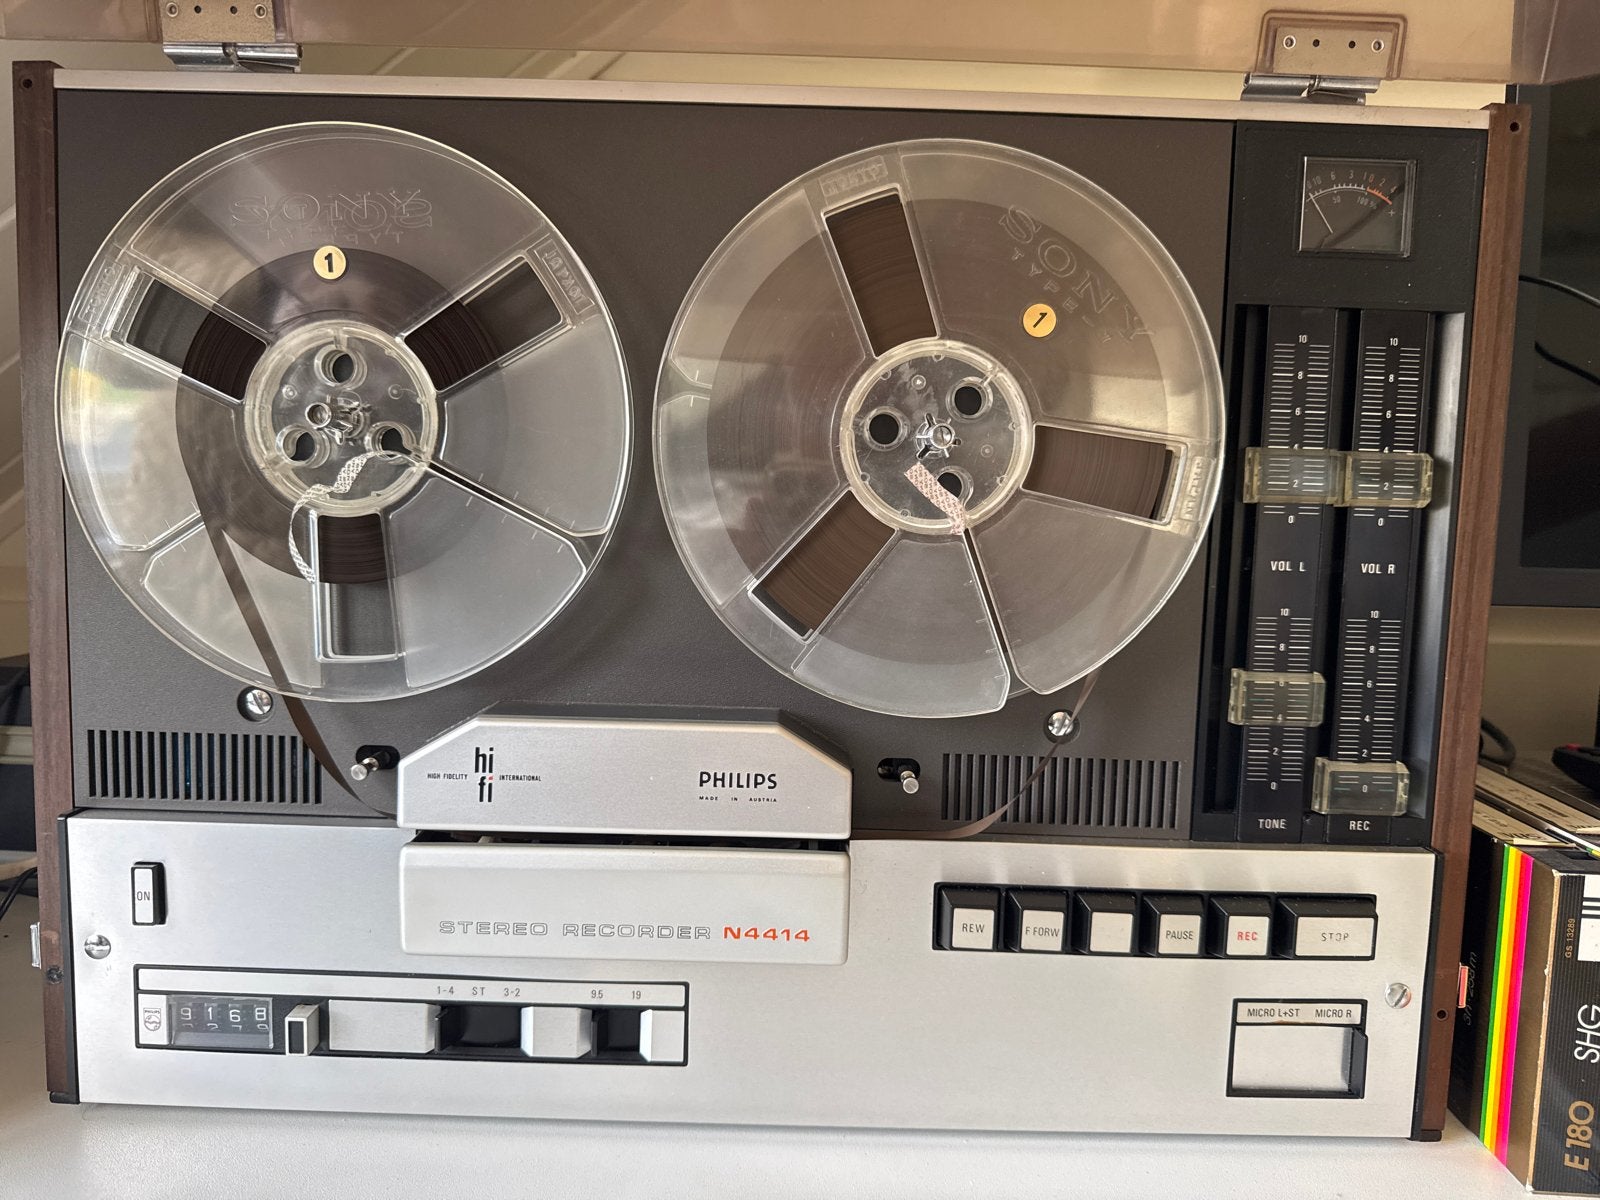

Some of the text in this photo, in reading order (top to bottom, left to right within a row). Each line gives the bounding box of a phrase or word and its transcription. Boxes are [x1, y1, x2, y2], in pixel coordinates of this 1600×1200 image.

[324, 252, 334, 273] 1
[999, 204, 1155, 344] SONY
[1033, 312, 1048, 328] 1
[1298, 334, 1308, 344] 10
[1389, 337, 1399, 347] 10
[1297, 371, 1304, 380] 8
[1388, 374, 1395, 383] 8
[1295, 407, 1301, 416] 6
[1385, 410, 1392, 419] 6
[1292, 480, 1299, 488] 2
[1383, 482, 1390, 491] 2
[1287, 515, 1295, 525] 0
[1378, 517, 1385, 527] 0
[1270, 560, 1306, 572] VOL L
[1360, 563, 1396, 574] VOL R
[1280, 608, 1290, 617] 10
[1370, 610, 1380, 619] 10
[1279, 643, 1285, 652] 8
[1369, 645, 1375, 654] 8
[1366, 680, 1373, 689] 6
[1364, 714, 1370, 723] 4
[1272, 747, 1279, 756] 2
[1362, 749, 1368, 757] 2
[474, 746, 494, 774] hi
[443, 773, 468, 781] FIDELITY
[499, 774, 542, 782] INTERNATIONAL
[698, 770, 778, 790] PHILIPS
[478, 775, 494, 803] fi
[1270, 782, 1277, 790] 0
[1362, 785, 1368, 793] 0
[1257, 818, 1287, 830] TONE
[1349, 820, 1370, 832] REC
[136, 890, 151, 901] ON
[439, 920, 811, 943] STEREO RECORDER N4414
[961, 922, 986, 934] REW
[1025, 926, 1061, 938] F FORW
[1165, 930, 1194, 941] PAUSE
[1236, 931, 1259, 942] REC
[1320, 931, 1350, 942] STOP
[1565, 918, 1576, 959] GS 13289
[436, 986, 456, 996] 1-4
[471, 987, 487, 996] ST
[503, 987, 521, 997] 3-2
[631, 990, 642, 1000] 19
[1247, 1008, 1301, 1018] MICRO L+ST
[1315, 1009, 1352, 1018] MICRO R
[1574, 1003, 1600, 1065] SHG
[1564, 1100, 1595, 1173] E 180
